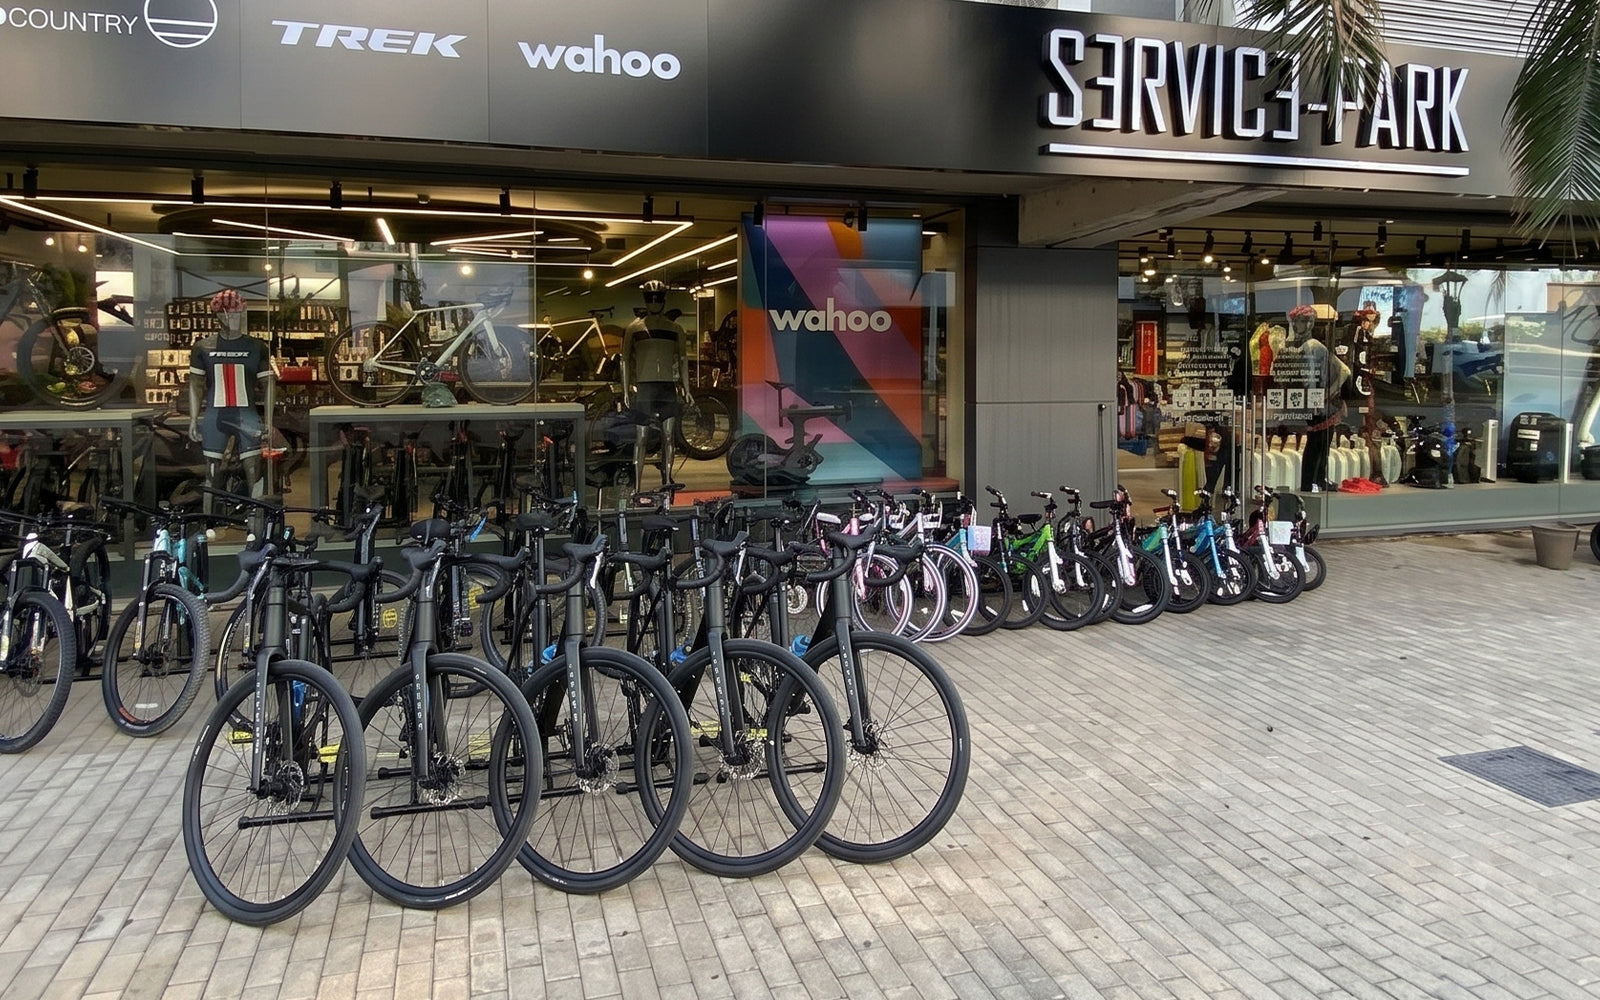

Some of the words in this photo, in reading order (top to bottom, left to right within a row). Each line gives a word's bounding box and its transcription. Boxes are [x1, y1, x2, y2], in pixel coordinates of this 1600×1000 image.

[0, 7, 138, 35] COUNTRY
[271, 20, 468, 59] TREK
[517, 34, 682, 81] wahoo
[768, 297, 893, 333] wahoo
